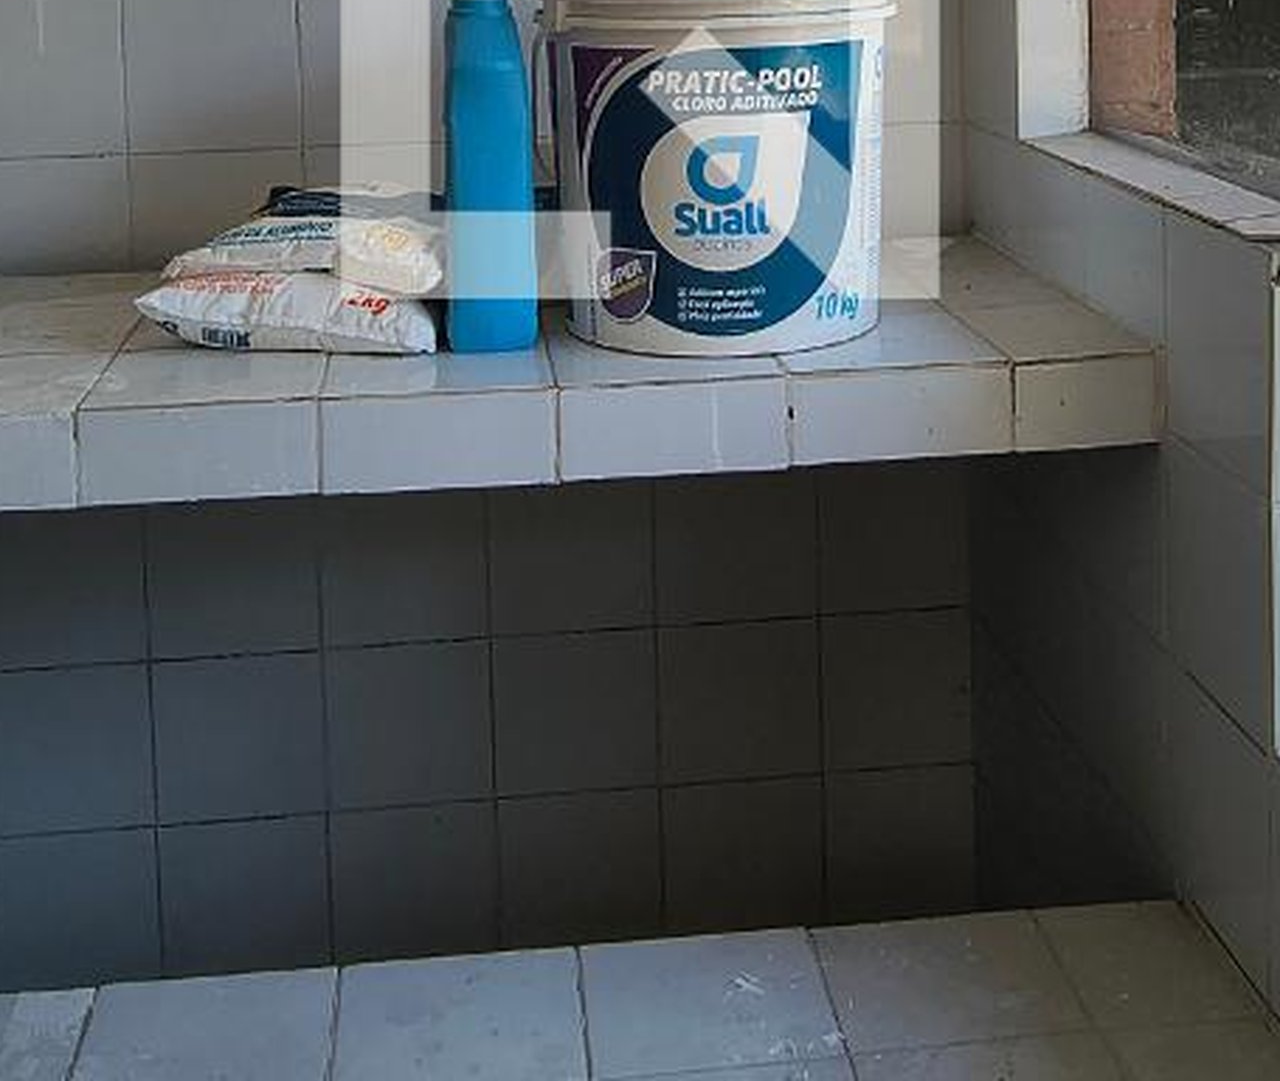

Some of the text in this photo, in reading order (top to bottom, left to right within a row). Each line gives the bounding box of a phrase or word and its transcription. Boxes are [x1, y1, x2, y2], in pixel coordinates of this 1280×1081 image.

[647, 65, 822, 94] PRATIC-POOL
[671, 90, 818, 112] CLORO ADITIVADO
[674, 201, 770, 236] Suall
